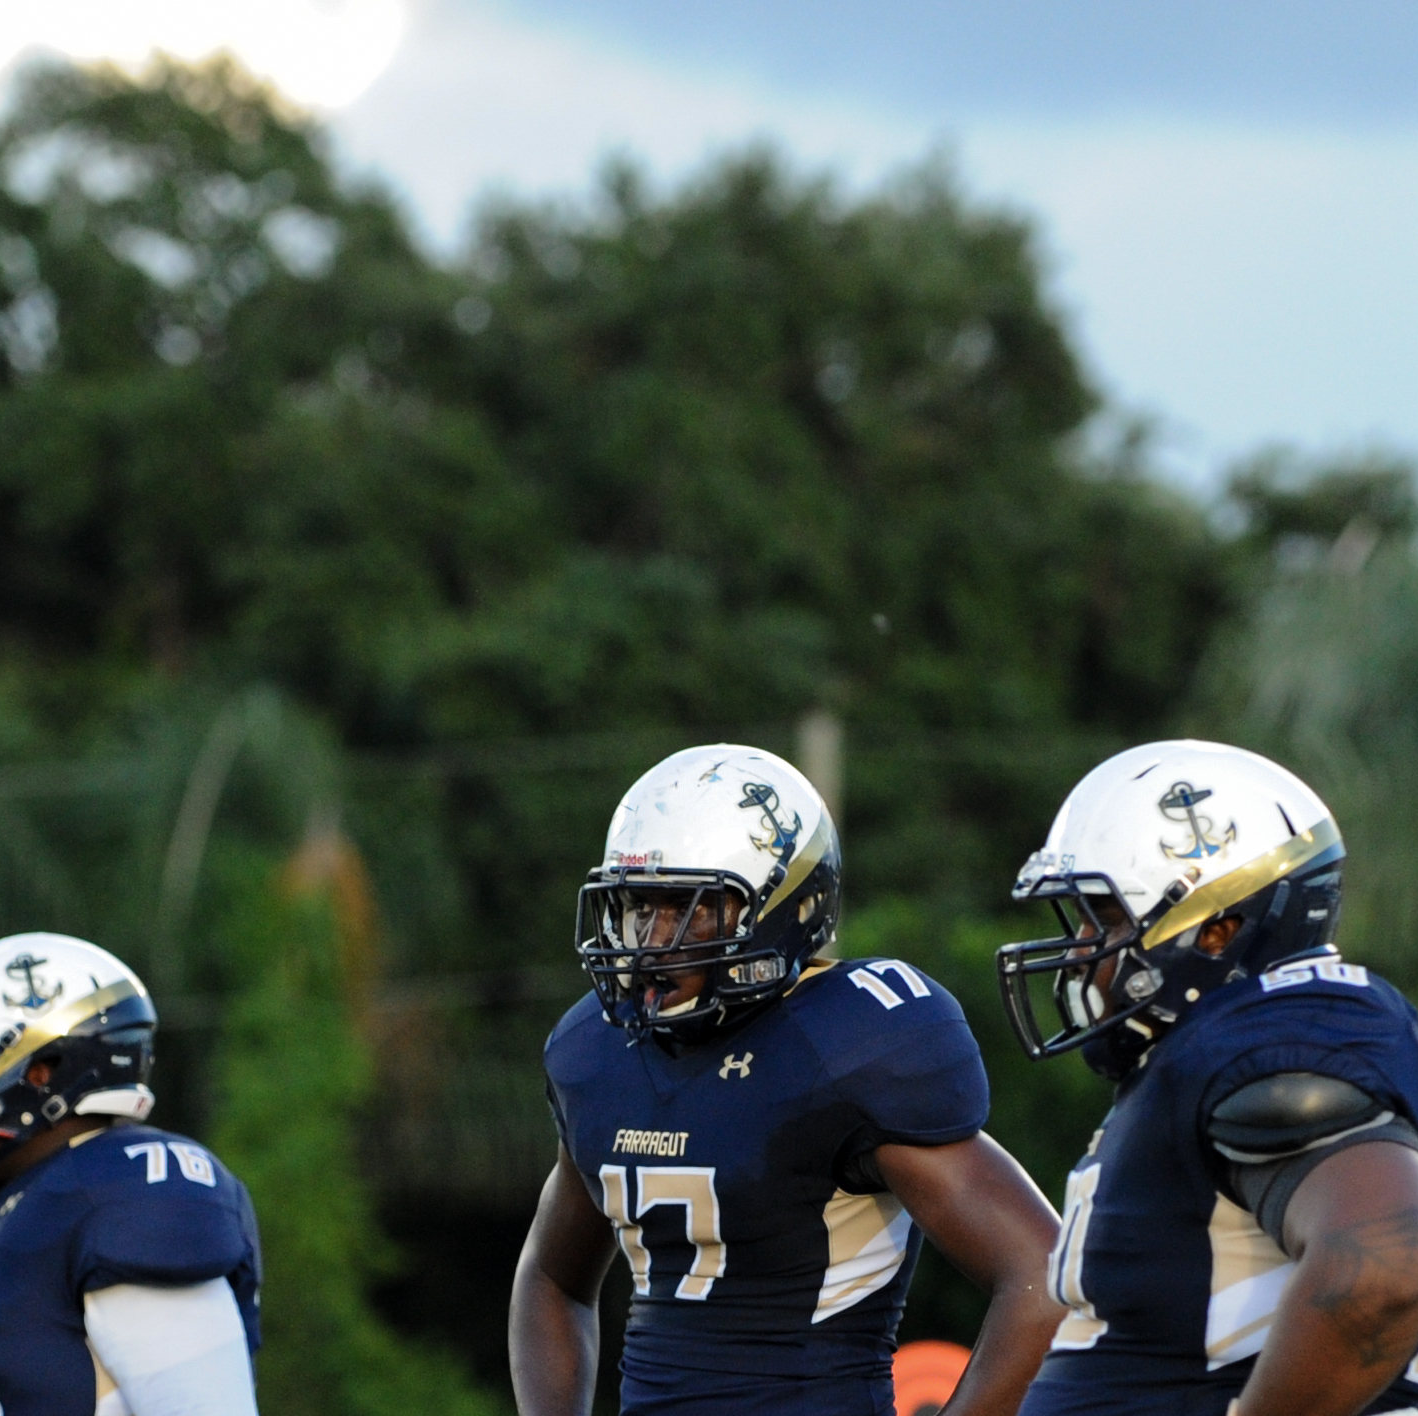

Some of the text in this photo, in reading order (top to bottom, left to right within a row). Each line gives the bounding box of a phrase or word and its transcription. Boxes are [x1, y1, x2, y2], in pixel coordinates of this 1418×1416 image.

[847, 959, 932, 1010] 17
[123, 1141, 217, 1188] 76
[612, 1128, 689, 1157] FARRAGUT
[599, 1164, 726, 1301] 17
